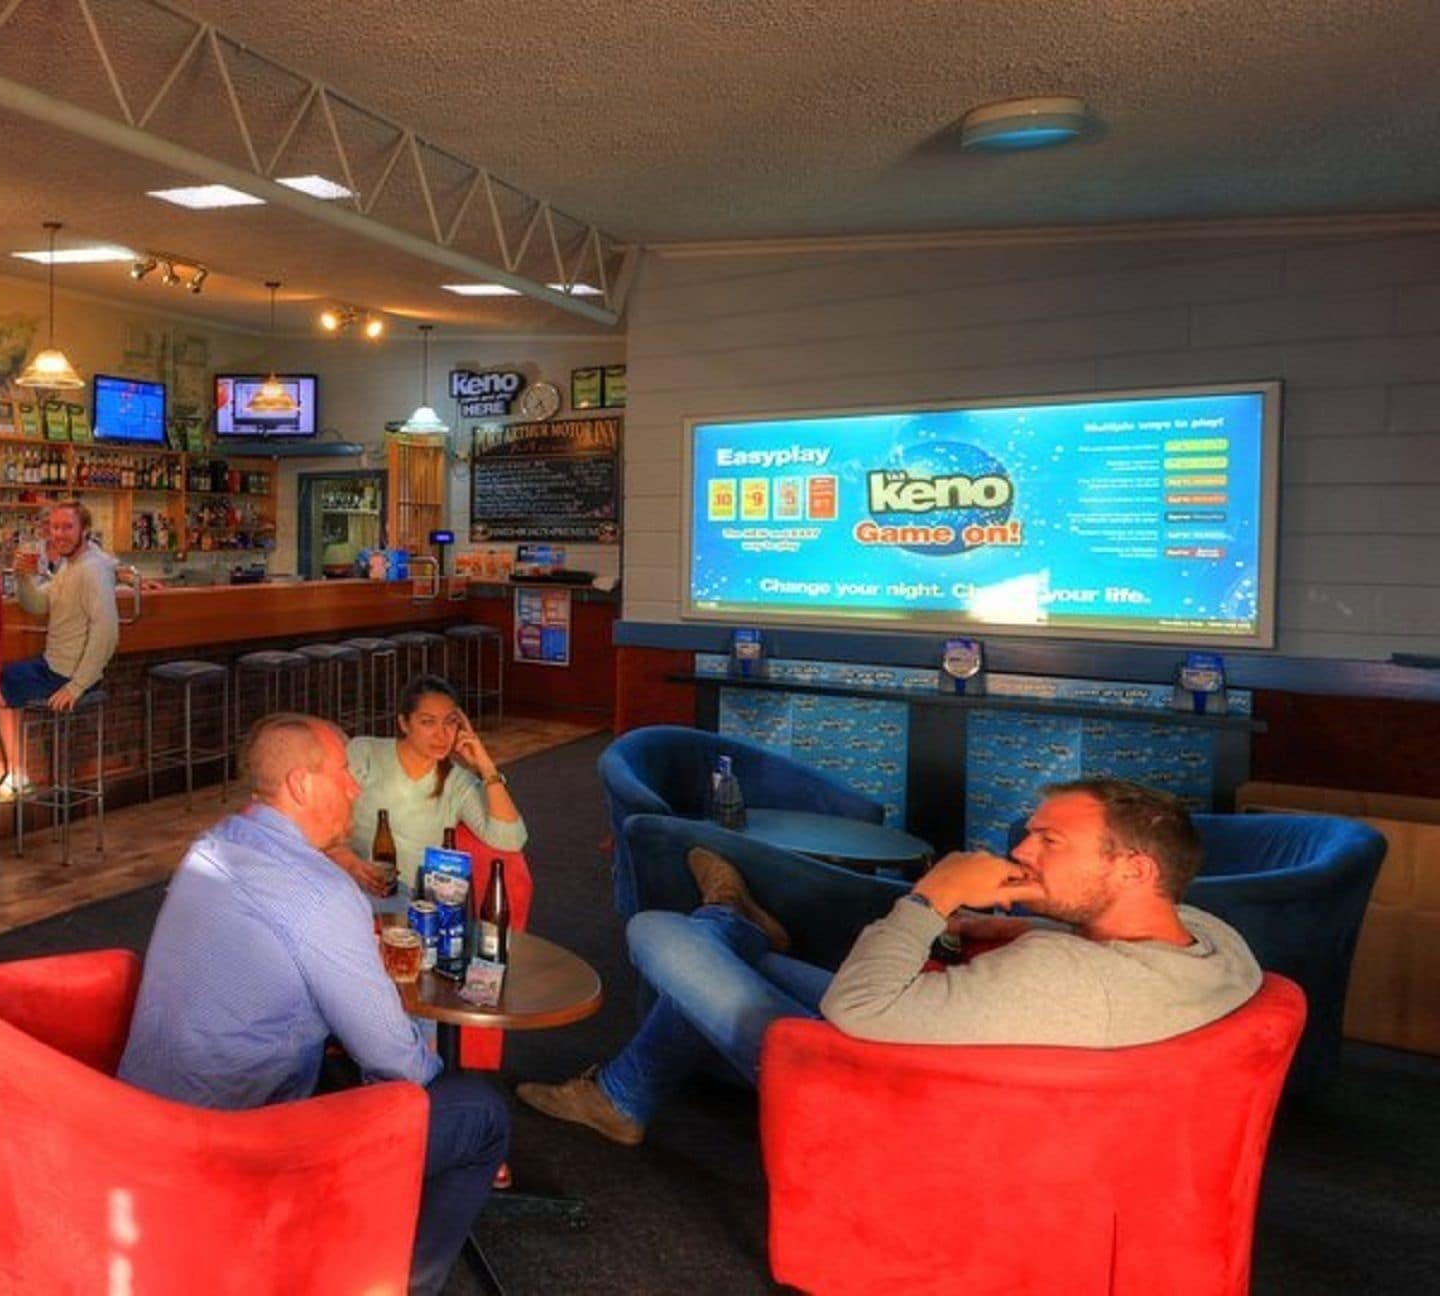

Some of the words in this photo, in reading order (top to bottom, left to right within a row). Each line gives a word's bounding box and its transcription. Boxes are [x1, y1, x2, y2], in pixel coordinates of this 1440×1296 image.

[463, 401, 506, 416] HERE
[716, 444, 831, 468] Easyplay
[854, 519, 955, 544] Game
[962, 518, 1021, 547] on!
[760, 577, 830, 596] Change
[837, 582, 880, 597] your
[886, 582, 945, 600] night.
[1104, 587, 1152, 604] life.
